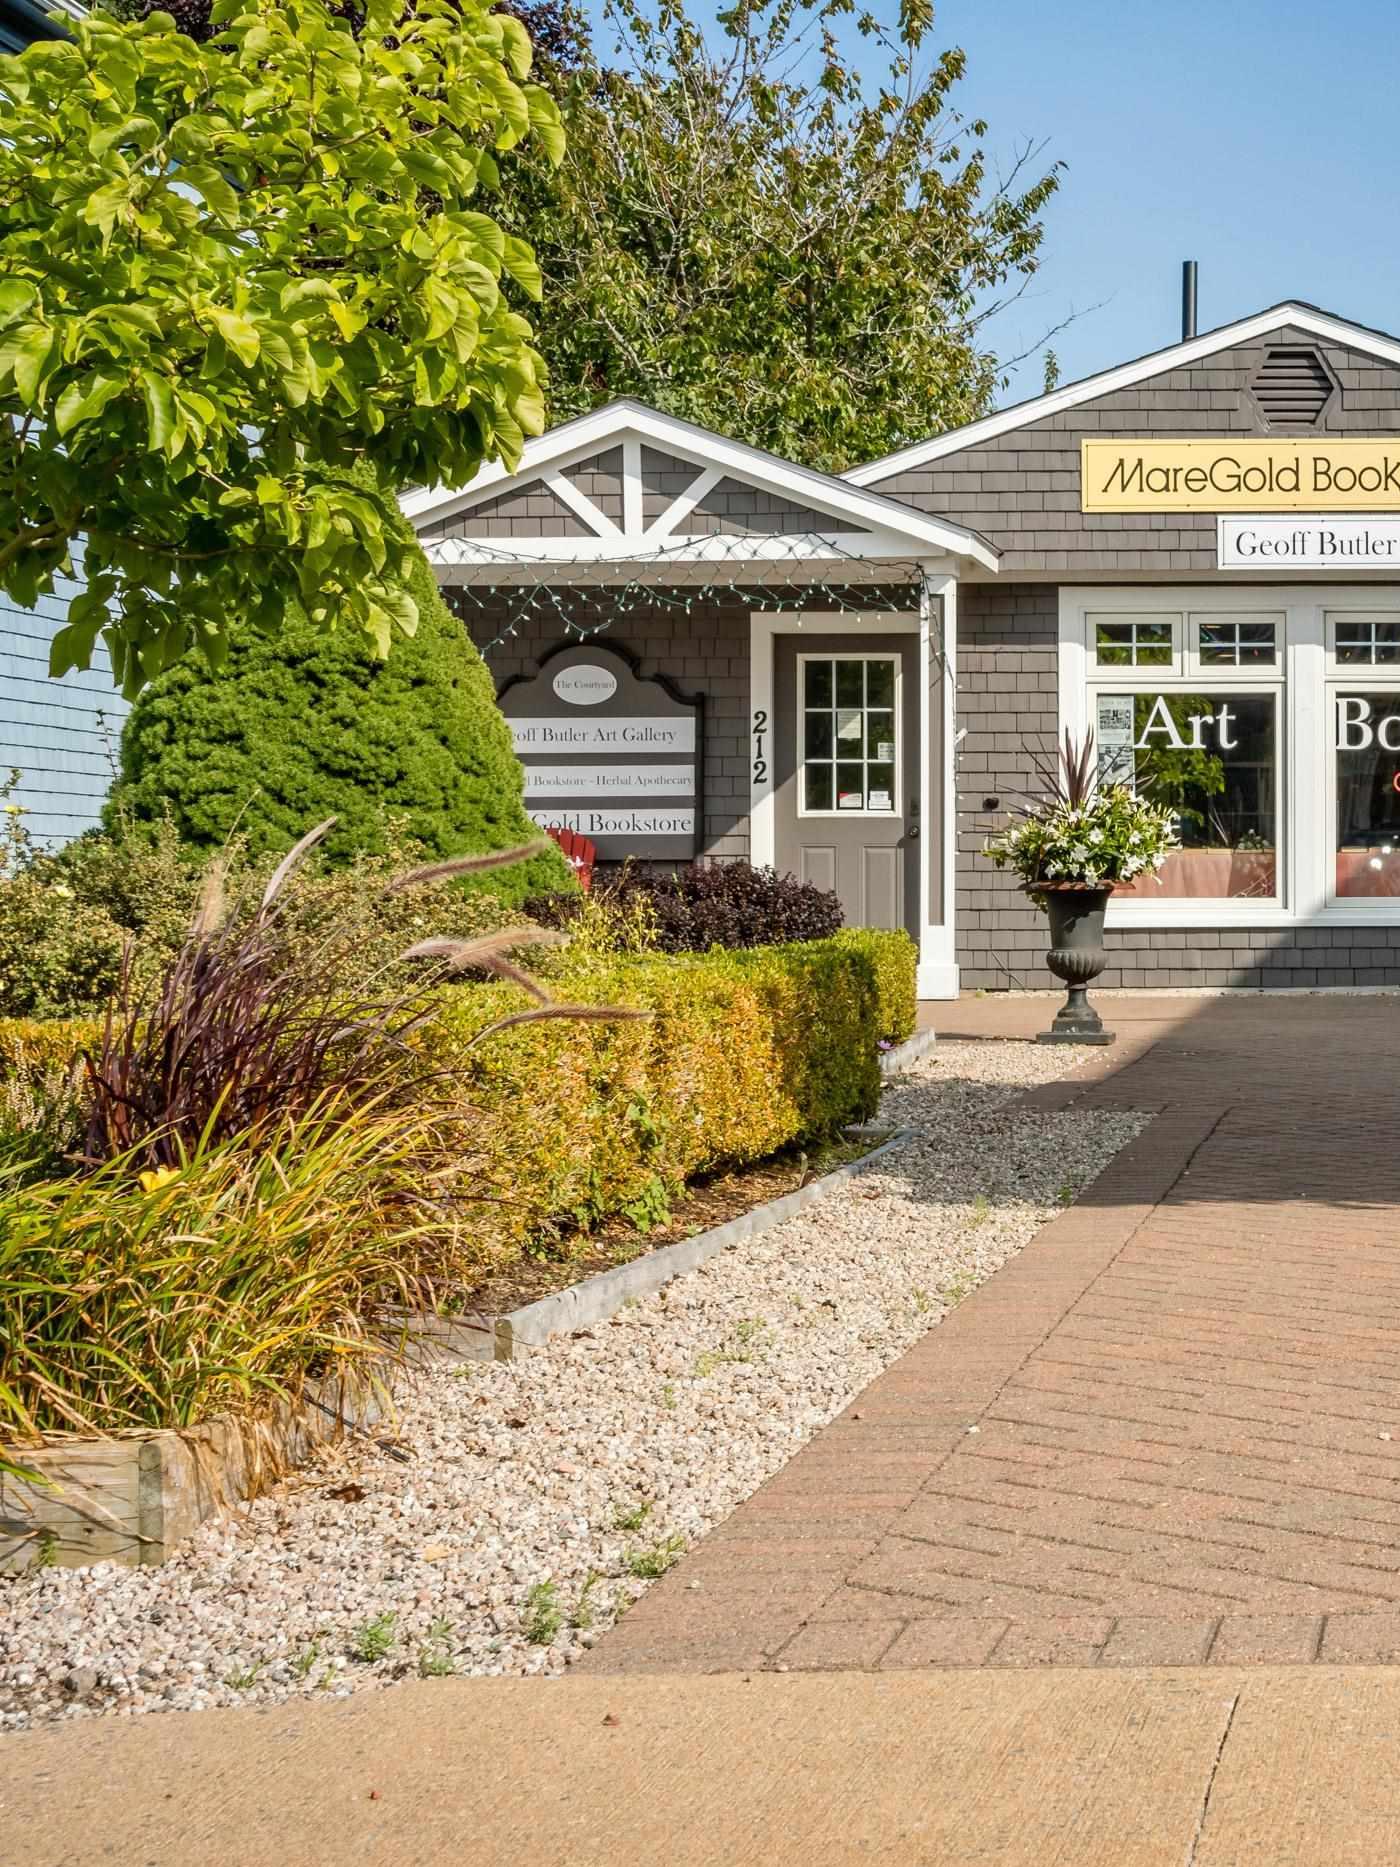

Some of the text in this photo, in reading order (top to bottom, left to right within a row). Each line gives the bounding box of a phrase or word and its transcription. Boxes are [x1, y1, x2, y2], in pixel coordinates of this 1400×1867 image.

[1101, 457, 1301, 493] MareGold
[1236, 531, 1312, 557] Geoff
[1318, 530, 1398, 556] Butler
[542, 727, 589, 742] Butler
[592, 727, 617, 742] Art
[622, 727, 678, 744] Gallery
[1133, 695, 1239, 750] Art
[752, 710, 768, 785] 212
[596, 775, 632, 786] Herbal
[633, 775, 693, 788] Apothecary
[589, 813, 692, 832] Bookstore
